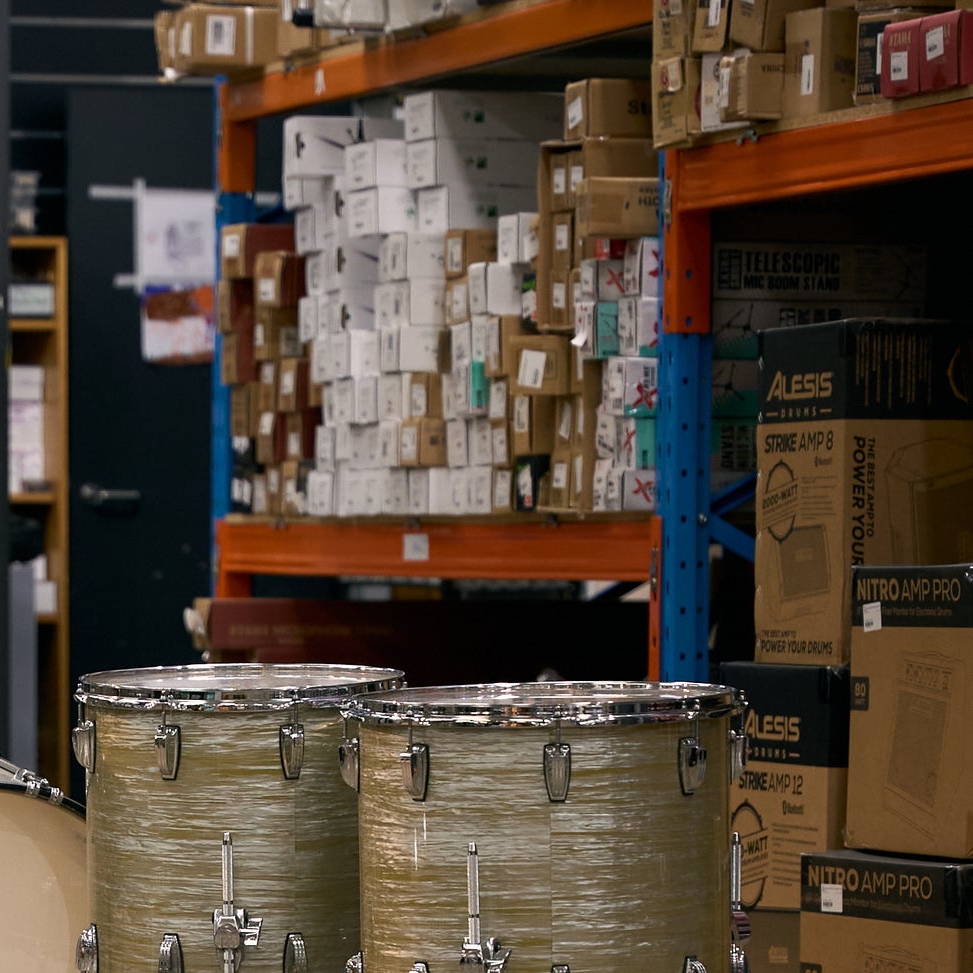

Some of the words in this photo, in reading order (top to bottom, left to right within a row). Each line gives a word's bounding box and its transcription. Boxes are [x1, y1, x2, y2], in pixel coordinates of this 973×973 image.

[745, 251, 841, 274] TELESCOPIC
[744, 275, 764, 290] MIC
[768, 275, 800, 291] BOOM
[803, 276, 840, 291] STAND
[766, 370, 834, 402] ALESIS
[780, 408, 817, 418] DRUMS
[765, 433, 797, 453] STRIKE
[798, 431, 824, 452] AMP
[826, 430, 834, 450] 8
[867, 438, 876, 459] THE
[852, 436, 866, 508] POWER
[867, 462, 875, 491] BEST
[866, 493, 875, 520] AMP
[852, 514, 865, 566] YOUR
[866, 521, 875, 538] TO
[856, 577, 900, 601] NITRO
[901, 578, 930, 601] AMP
[932, 577, 962, 601] PRO
[760, 639, 785, 653] POWER
[787, 640, 806, 654] YOUR
[808, 641, 833, 655] DRUMS
[854, 682, 866, 697] 80
[745, 709, 802, 742] ALESIS
[754, 746, 787, 760] DRUMS
[739, 771, 767, 791] STRIKE
[768, 773, 791, 793] AMP
[792, 775, 803, 795] 12
[861, 870, 896, 896] AMP
[899, 874, 933, 900] PRO
